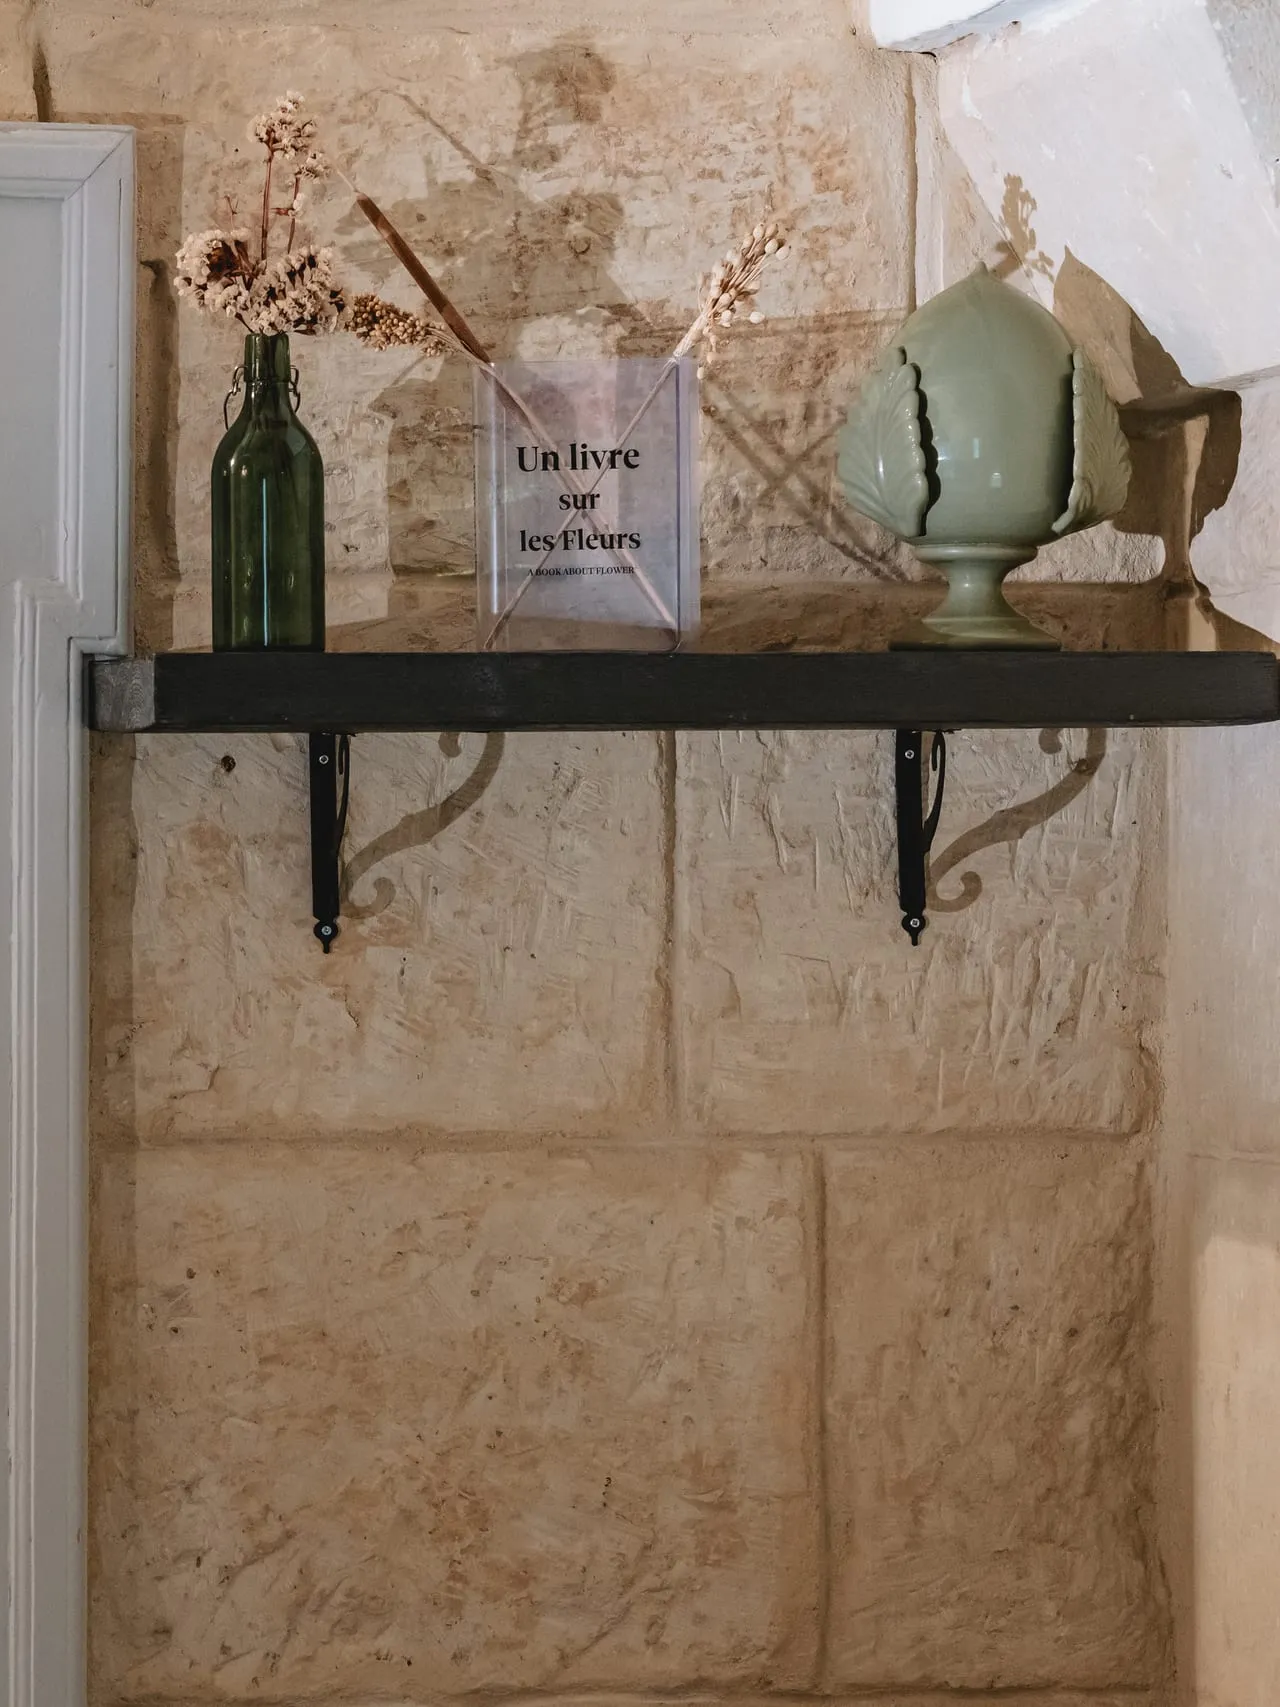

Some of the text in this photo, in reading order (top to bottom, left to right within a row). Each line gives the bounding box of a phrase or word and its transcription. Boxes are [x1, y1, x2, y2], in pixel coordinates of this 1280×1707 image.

[516, 443, 640, 472] Un livre
[558, 492, 600, 511] sur
[520, 528, 641, 551] les Fleurs
[535, 567, 561, 576] BOOK
[563, 566, 595, 576] ABOUT
